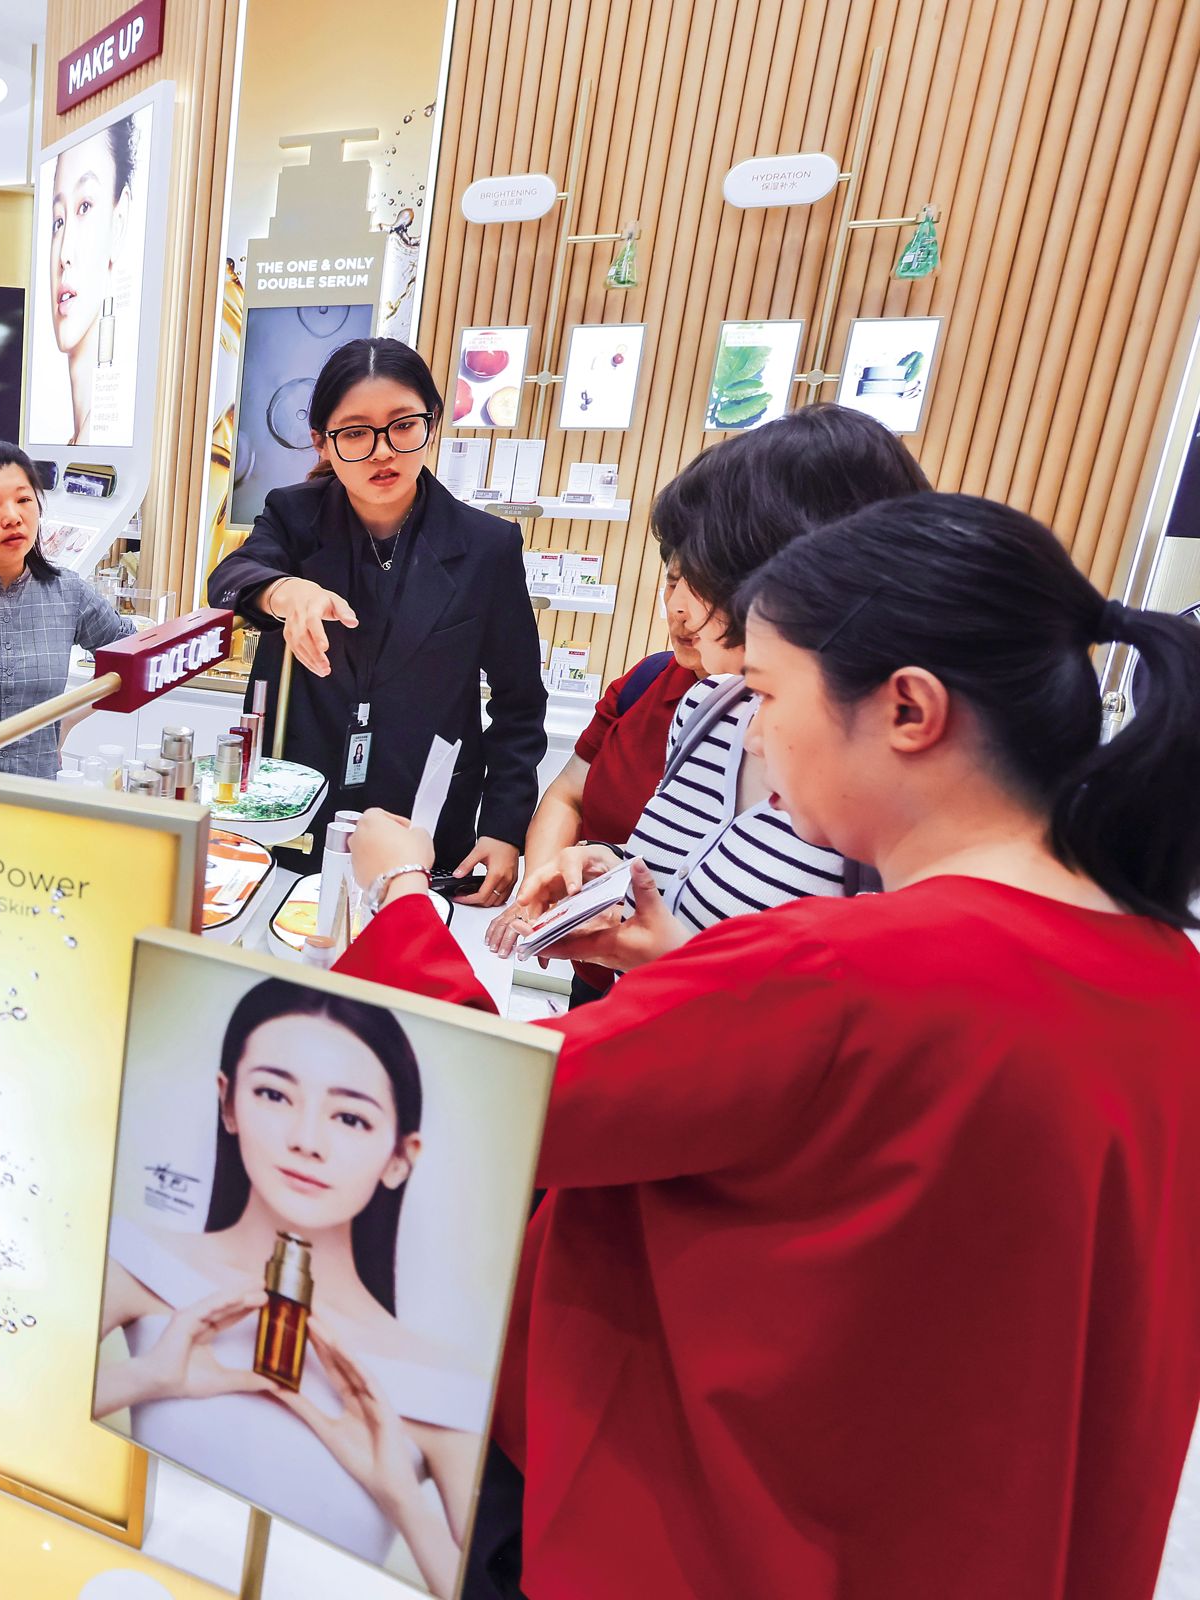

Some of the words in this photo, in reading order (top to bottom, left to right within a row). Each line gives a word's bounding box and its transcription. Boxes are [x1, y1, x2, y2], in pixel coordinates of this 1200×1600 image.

[68, 35, 115, 95] MAKE
[118, 16, 144, 61] UP
[751, 170, 811, 182] HYDRATION
[480, 188, 537, 200] BRIGHTENING
[256, 262, 283, 274] THE
[286, 259, 318, 273] ONE
[320, 258, 332, 271] &
[334, 256, 375, 271] ONLY
[257, 276, 315, 290] DOUBLE
[318, 274, 369, 288] SERUM
[147, 642, 189, 693] FACE
[187, 626, 226, 671] ONE
